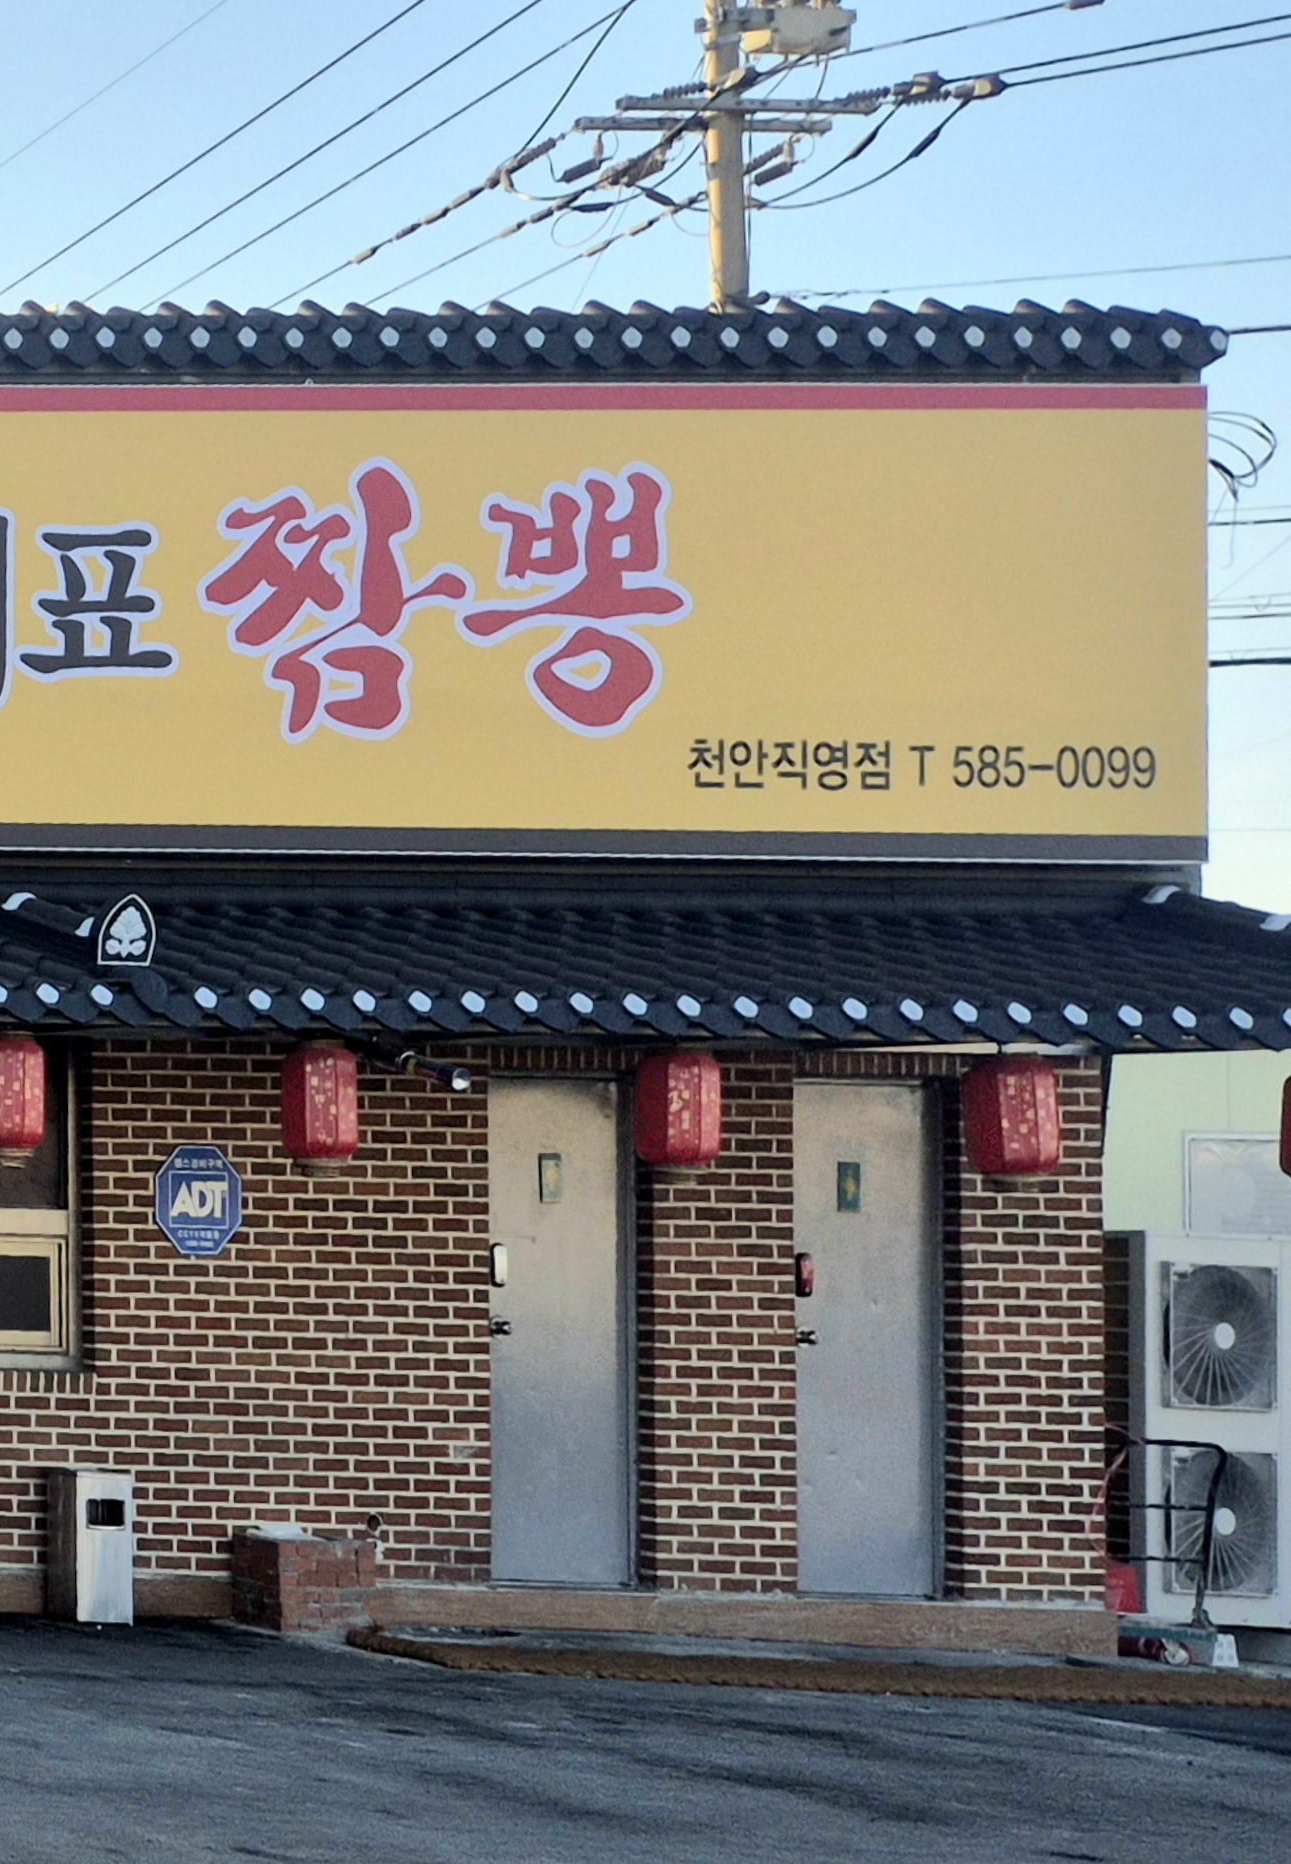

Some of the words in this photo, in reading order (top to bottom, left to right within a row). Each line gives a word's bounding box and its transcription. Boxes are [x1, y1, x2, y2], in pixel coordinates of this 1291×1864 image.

[201, 460, 690, 740] 짬뽕
[687, 738, 891, 791] 천안직영점
[909, 746, 935, 786] T
[952, 745, 1157, 788] 585-0099
[169, 1180, 229, 1219] ADT
